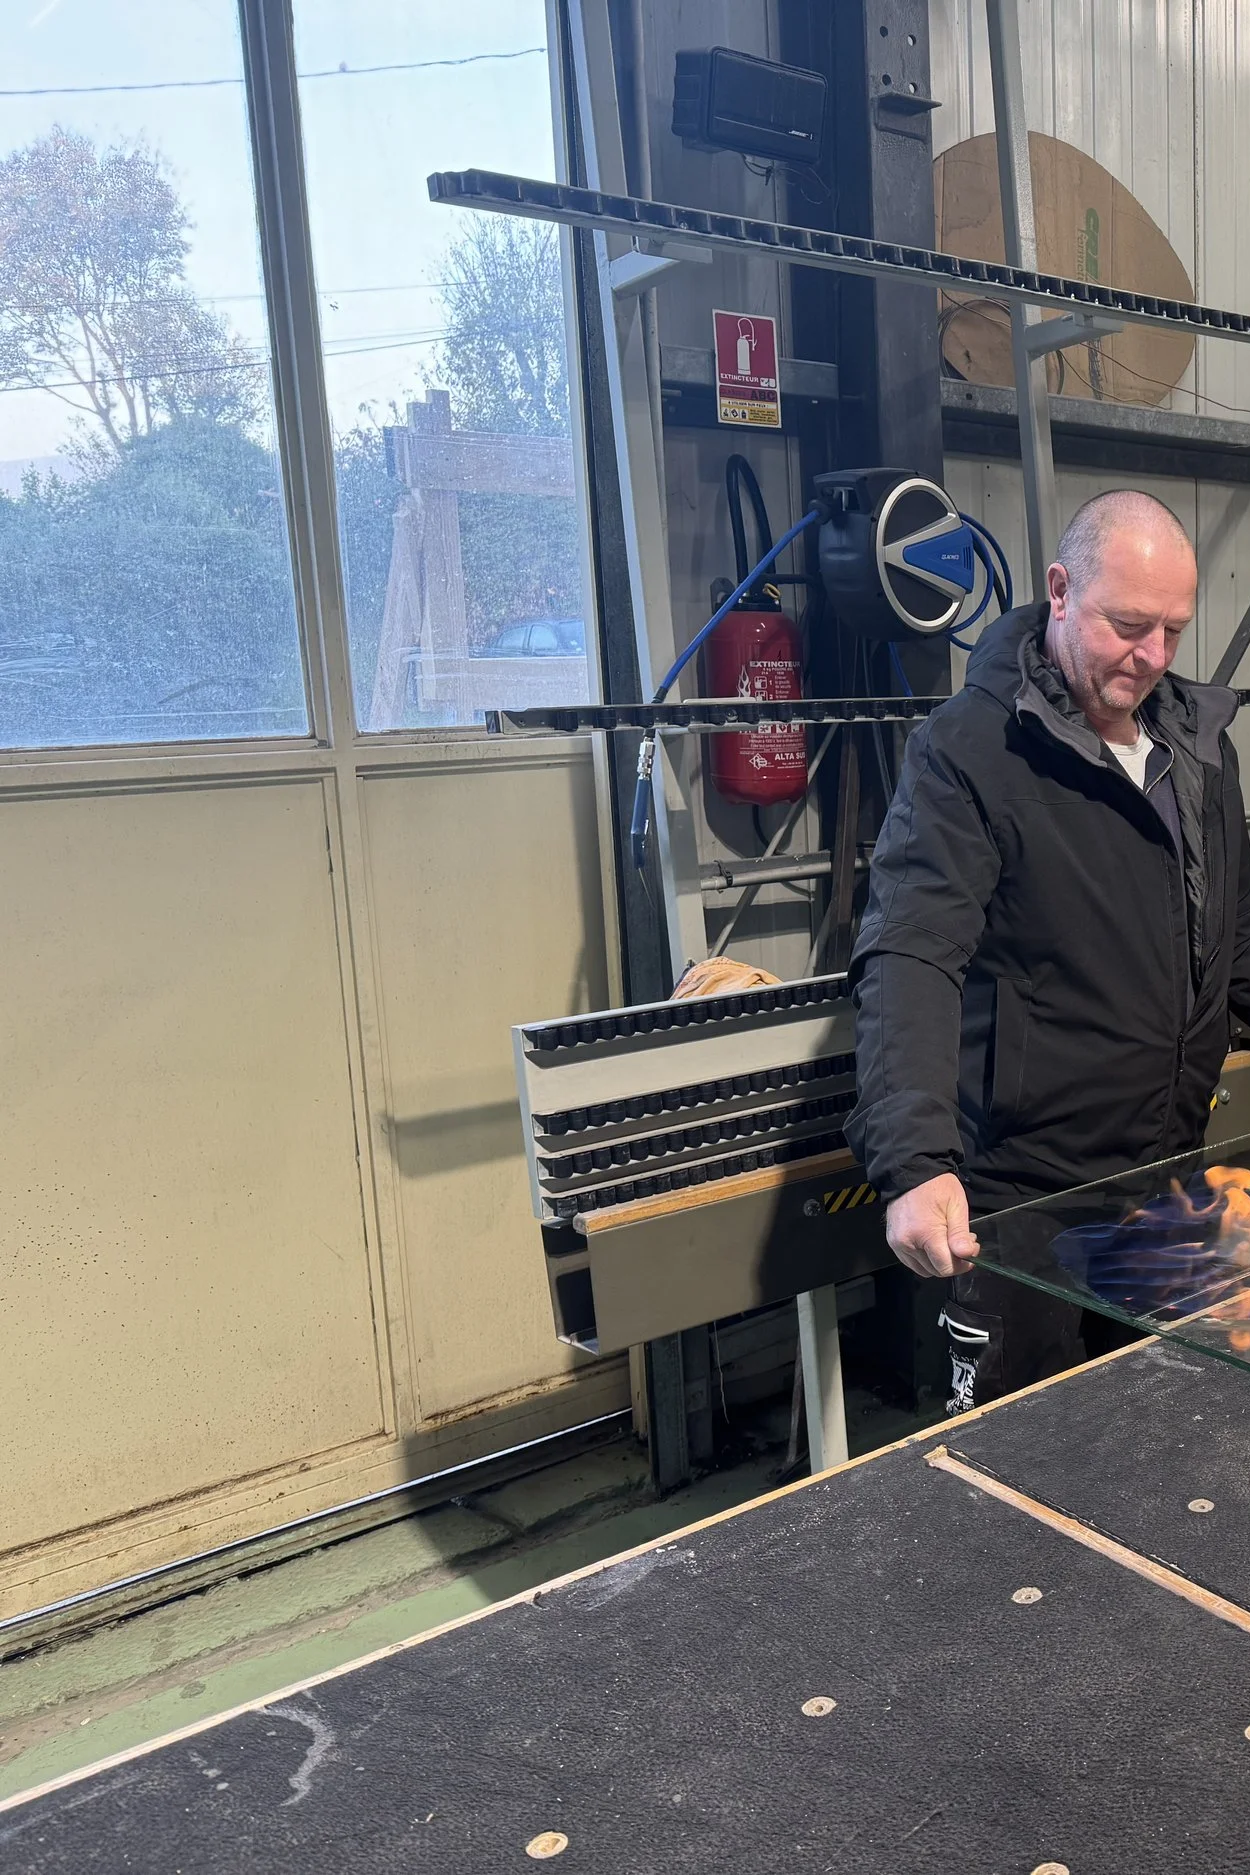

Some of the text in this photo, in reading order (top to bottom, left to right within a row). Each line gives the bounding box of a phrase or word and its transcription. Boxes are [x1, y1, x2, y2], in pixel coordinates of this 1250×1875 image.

[720, 373, 759, 382] EXTINCTEUR
[750, 390, 776, 401] ABC
[774, 752, 795, 761] ALTA
